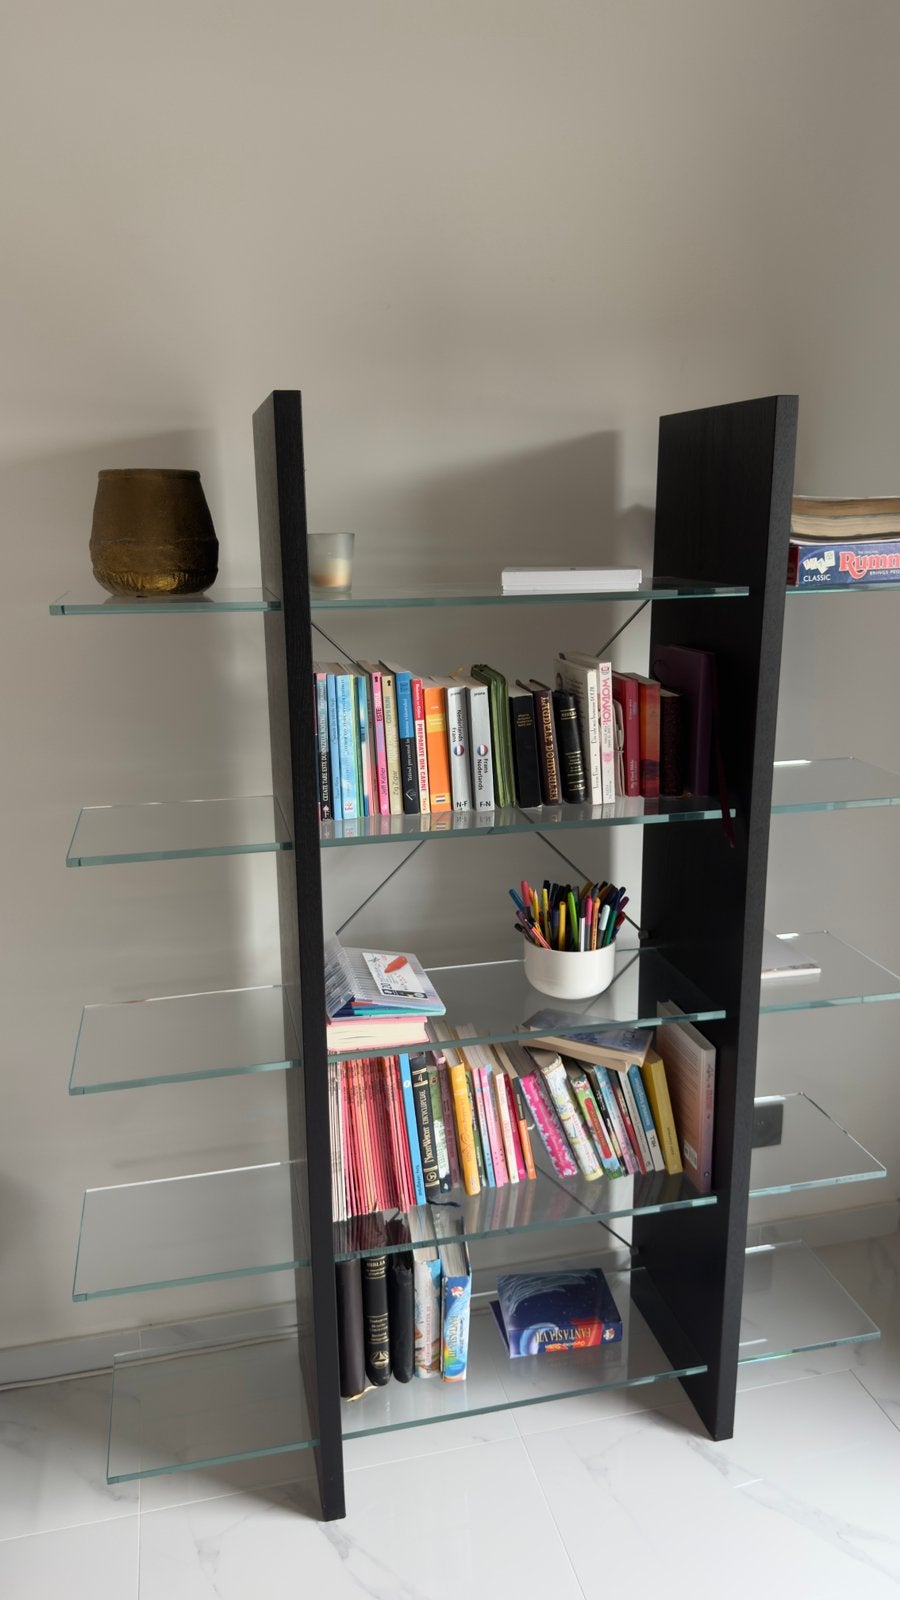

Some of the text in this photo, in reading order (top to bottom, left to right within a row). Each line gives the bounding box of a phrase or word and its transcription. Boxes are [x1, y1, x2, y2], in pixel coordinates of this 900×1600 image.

[803, 574, 831, 582] CLASSIC
[418, 1073, 422, 1082] 4
[549, 1327, 590, 1341] FANTASIA
